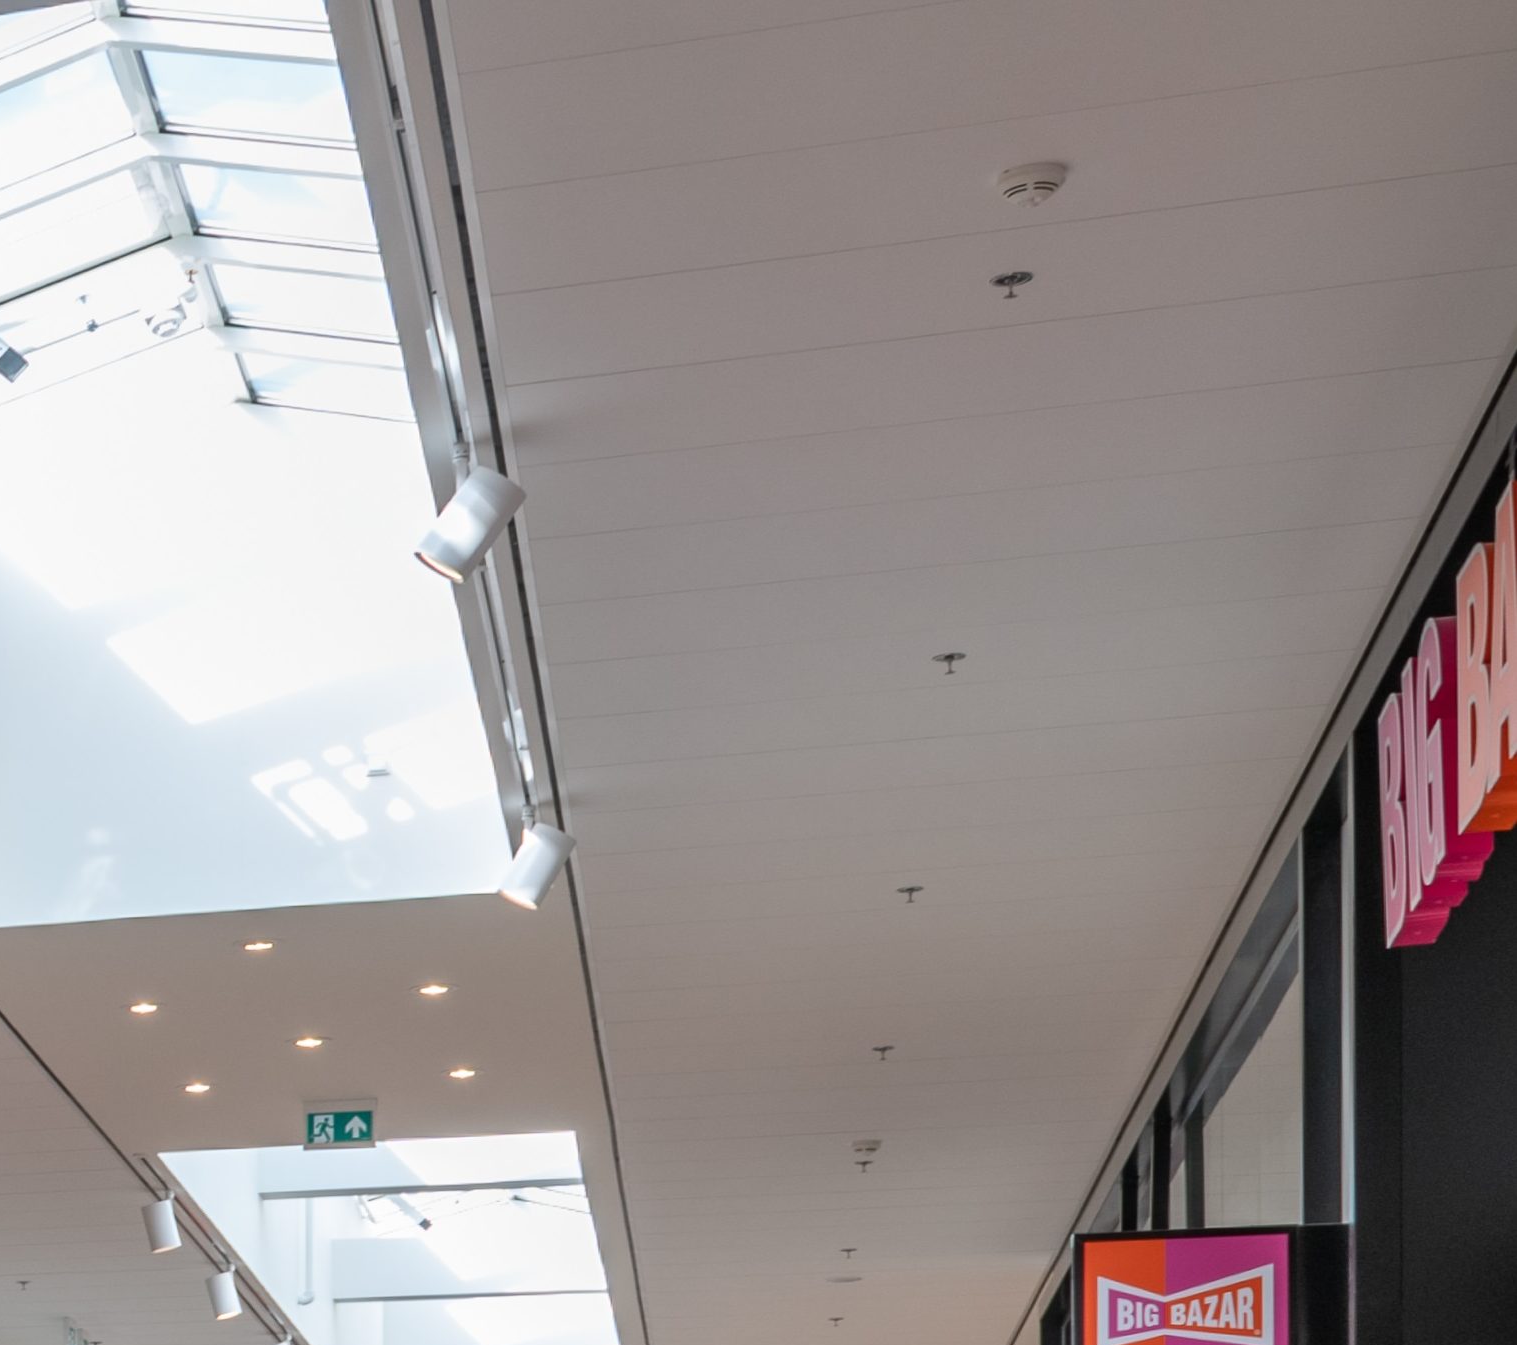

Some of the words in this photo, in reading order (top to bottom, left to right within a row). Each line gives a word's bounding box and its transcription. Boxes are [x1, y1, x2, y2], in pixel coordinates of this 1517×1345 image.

[1378, 616, 1447, 950] BIG
[1116, 1297, 1160, 1332] BIG
[1170, 1286, 1255, 1330] BAZAR
